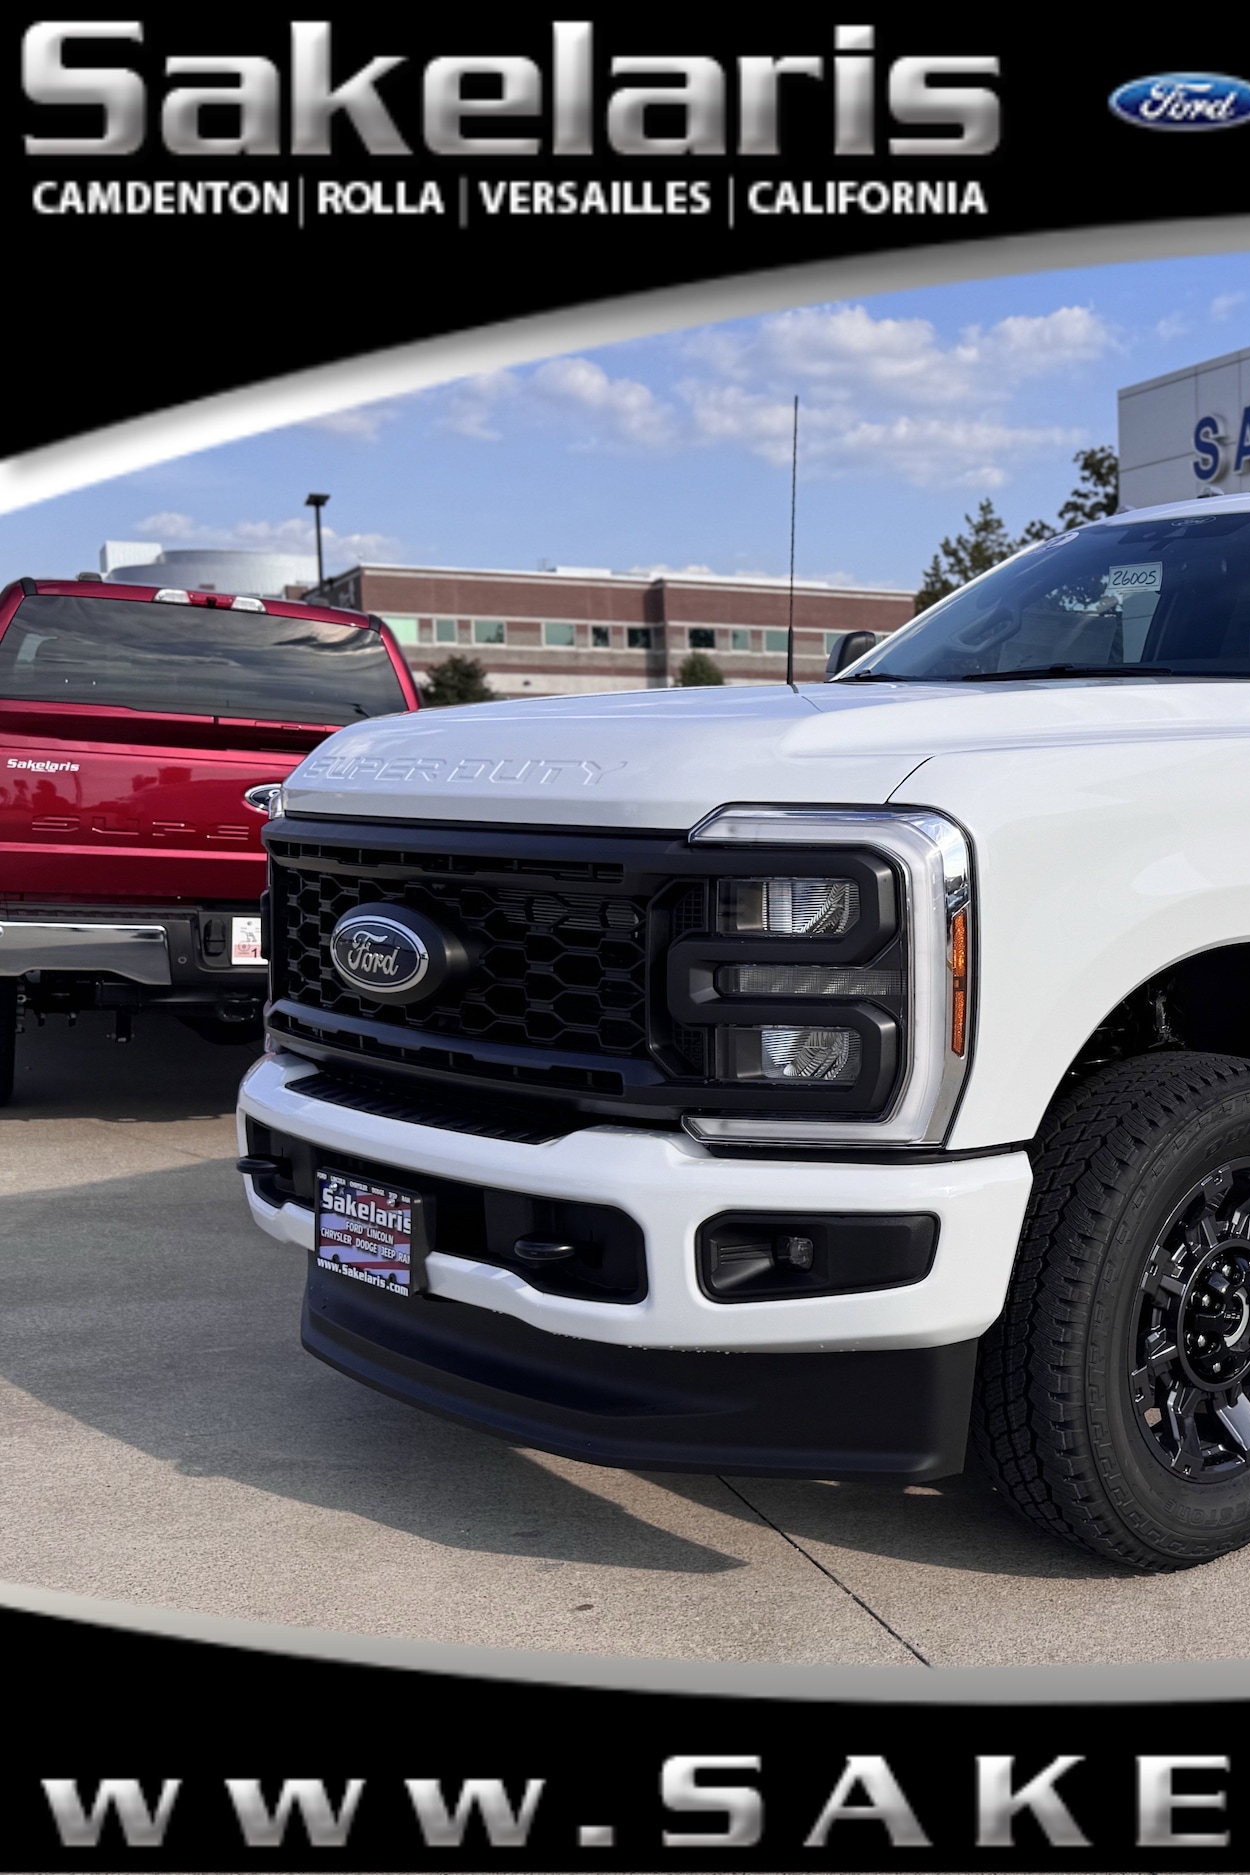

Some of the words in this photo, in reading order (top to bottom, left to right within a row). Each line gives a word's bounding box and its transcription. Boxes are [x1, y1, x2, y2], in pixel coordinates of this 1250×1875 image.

[1112, 570, 1157, 586] 26005
[7, 759, 80, 773] Sakelaris
[303, 756, 447, 783] SUPER
[447, 758, 628, 785] DUTY
[347, 930, 401, 976] Ford
[322, 1187, 412, 1235] Sakelaris
[320, 1227, 352, 1245] CHRYSLER
[355, 1238, 378, 1254] DODGE
[381, 1246, 396, 1259] JEEP
[345, 1221, 363, 1235] FORD
[366, 1228, 394, 1245] LINCOLN
[317, 1257, 409, 1297] www.Sakelaris.com
